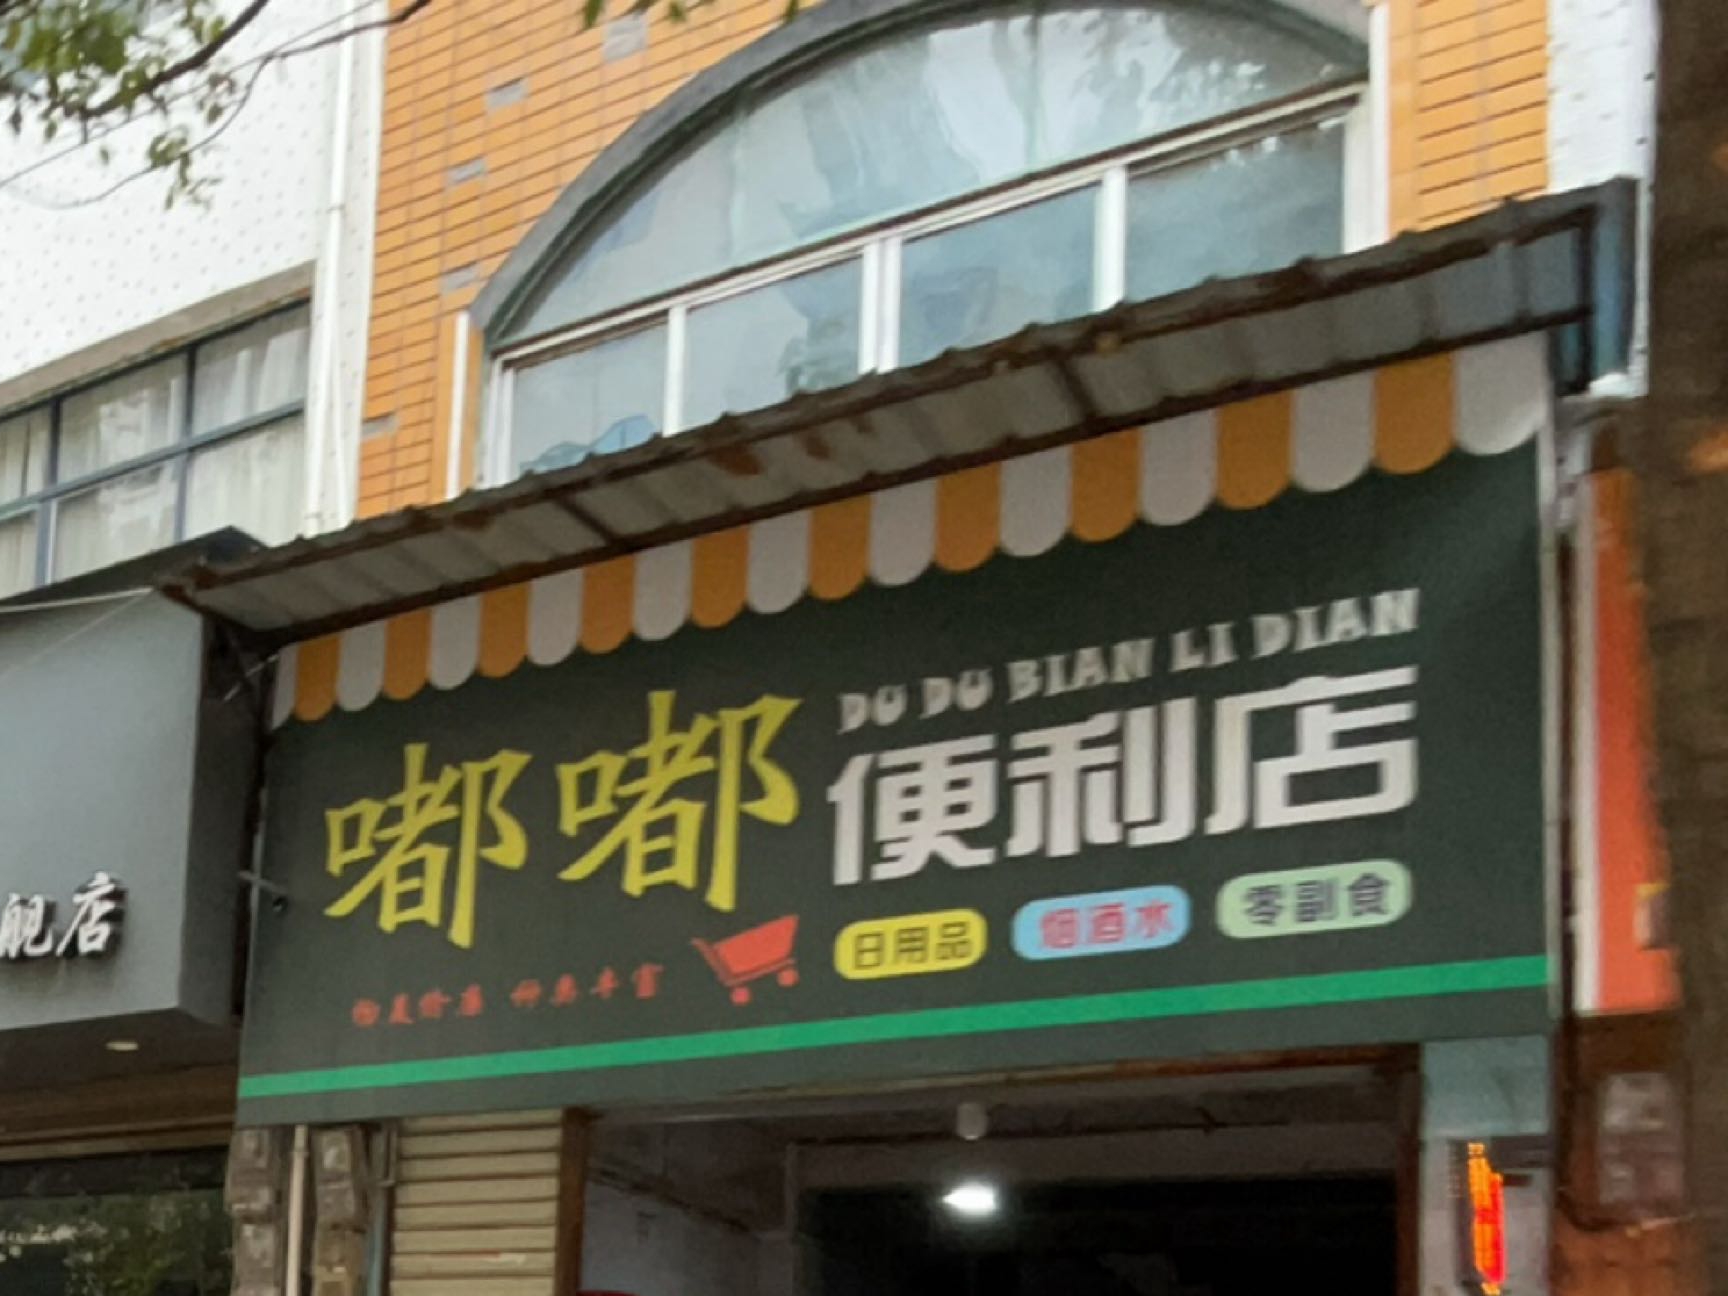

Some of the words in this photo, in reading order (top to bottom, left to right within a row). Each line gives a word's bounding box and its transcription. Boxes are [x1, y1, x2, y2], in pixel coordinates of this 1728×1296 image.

[839, 684, 907, 735] DU
[920, 668, 993, 720] DU
[1007, 638, 1156, 702] BIAN
[1171, 621, 1237, 672] LI
[1251, 587, 1421, 658] DIAN
[322, 690, 802, 948] 嘟嘟
[825, 665, 1419, 887] 便利店
[852, 921, 974, 970] 日用品
[1038, 897, 1173, 951] 烟酒水
[1242, 872, 1393, 926] 零副食
